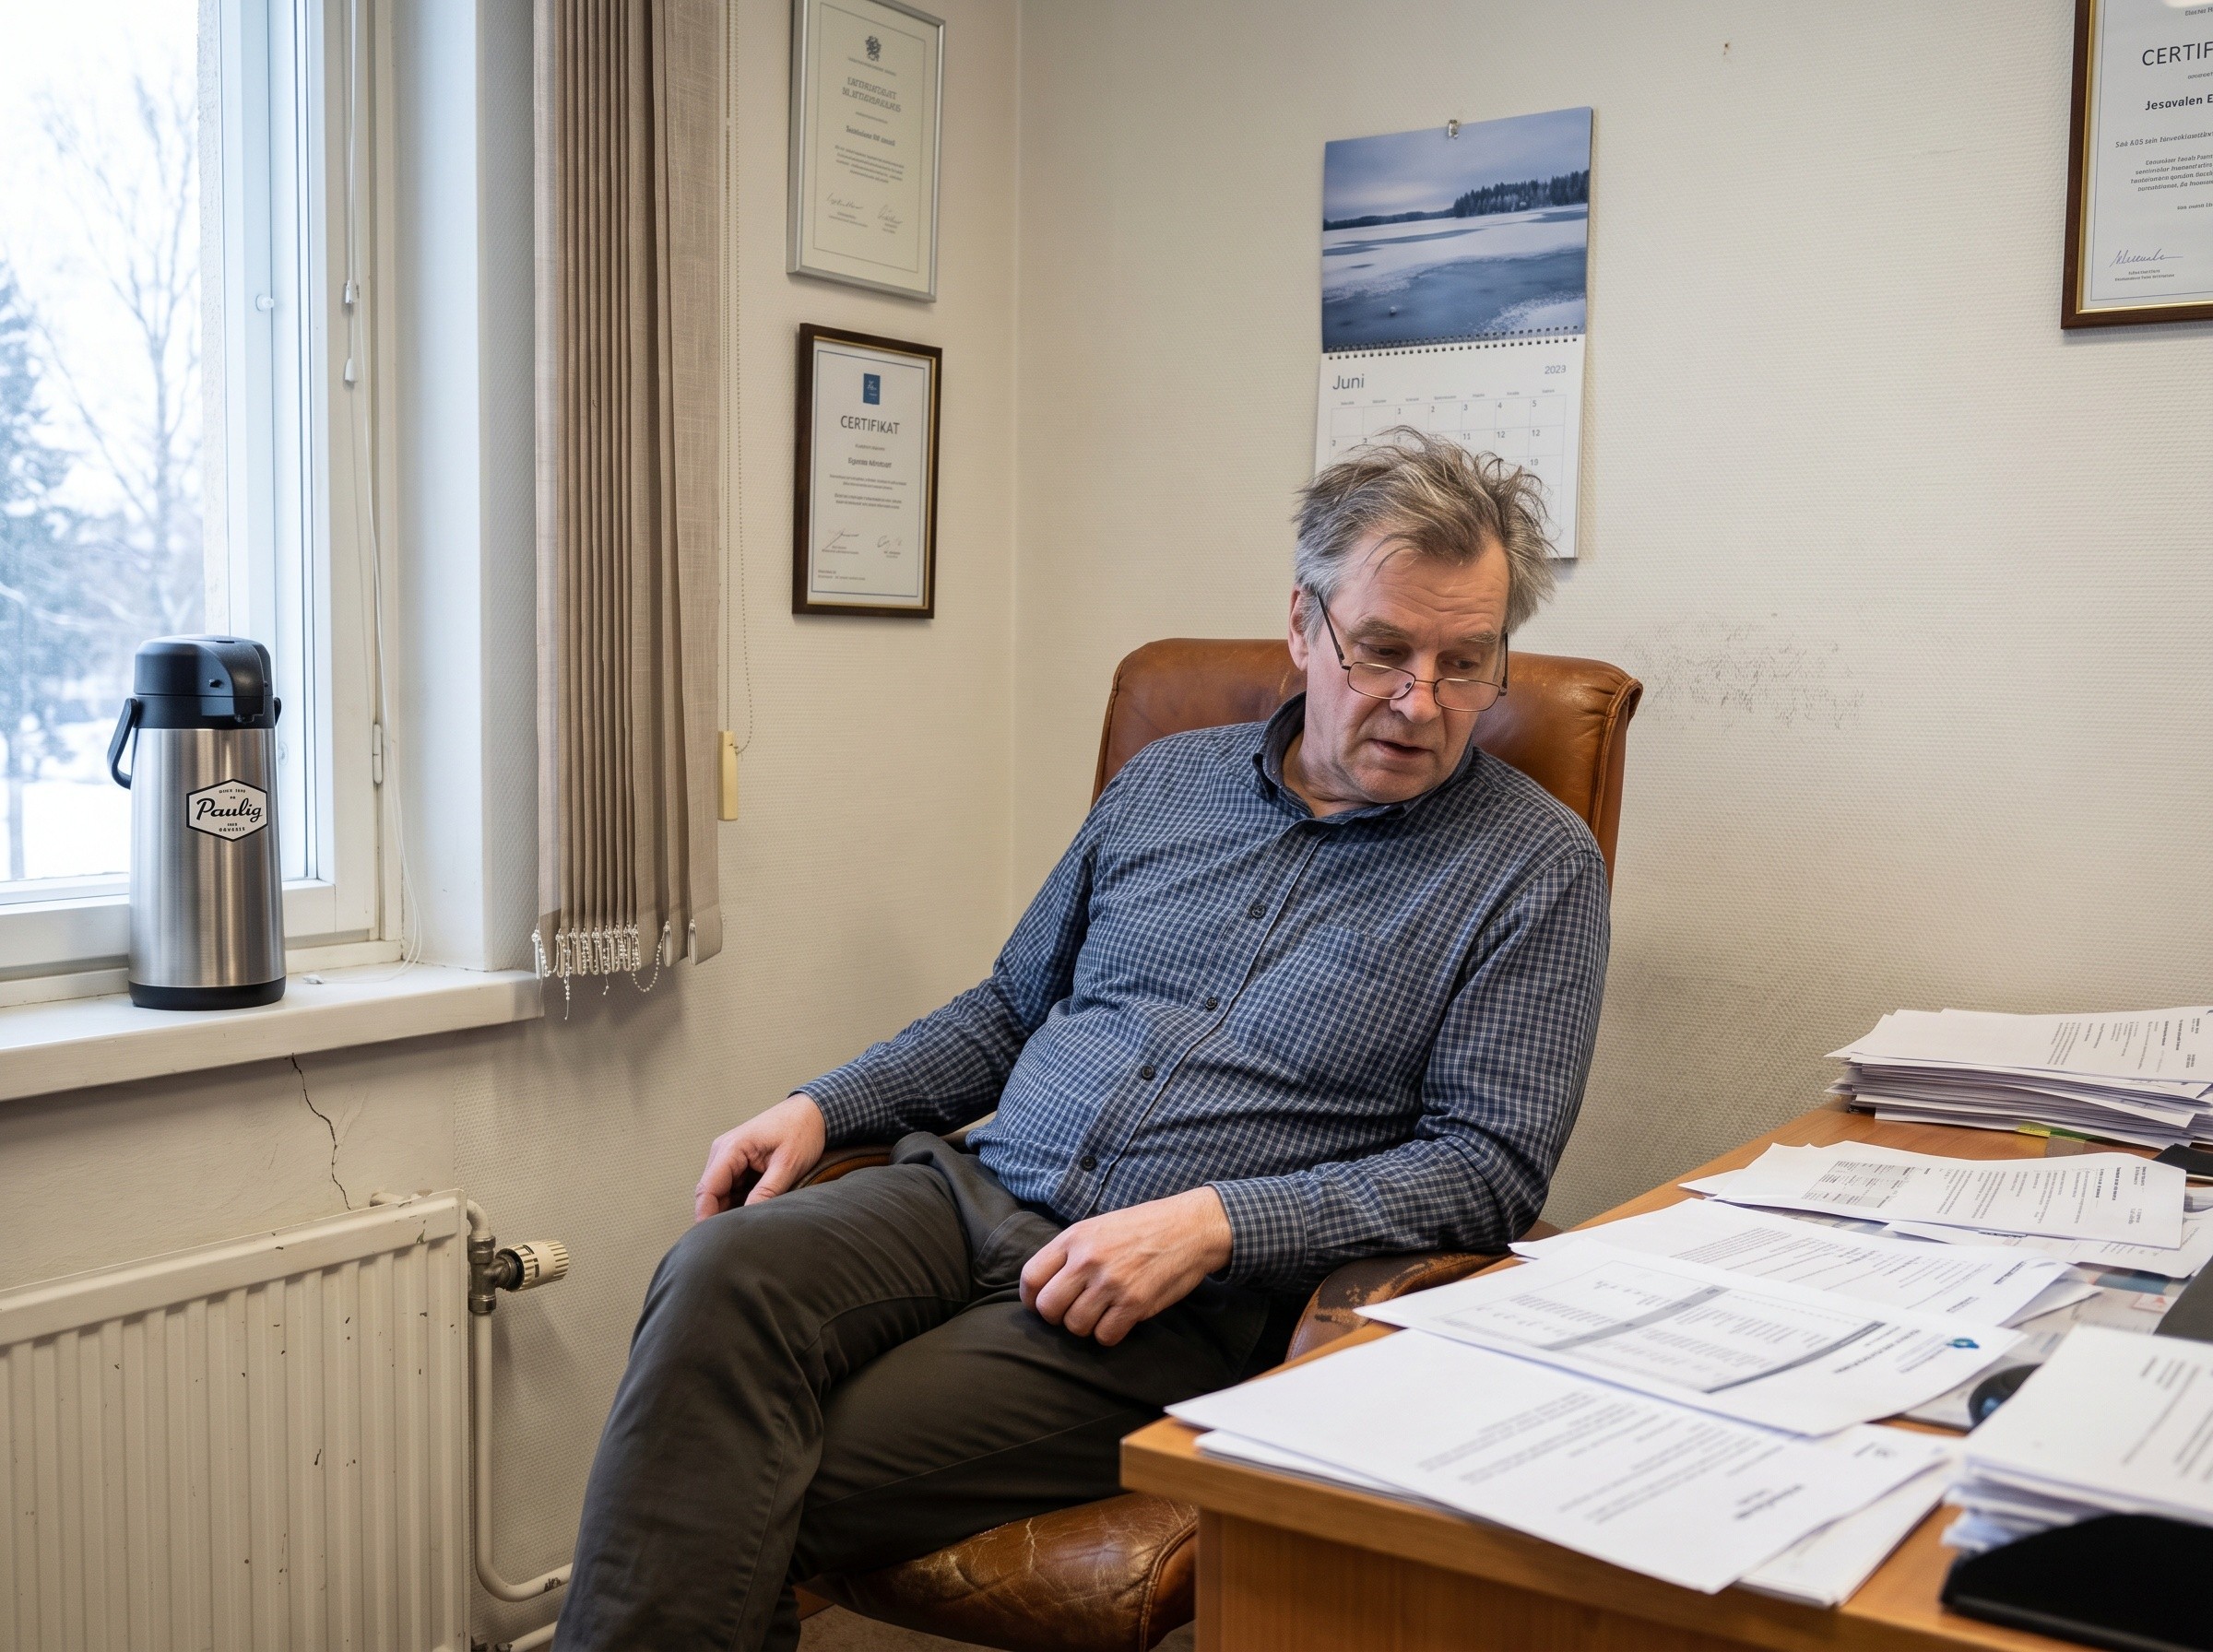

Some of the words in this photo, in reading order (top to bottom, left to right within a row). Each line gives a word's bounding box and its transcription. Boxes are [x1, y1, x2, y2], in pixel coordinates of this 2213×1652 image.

[2142, 41, 2213, 66] CERTIF
[1332, 373, 1365, 390] Juni
[1532, 399, 1537, 407] 5
[840, 415, 900, 434] CERTIFIKAT
[1497, 431, 1506, 439] 12
[1532, 429, 1541, 437] 12
[196, 797, 263, 823] Paulig
